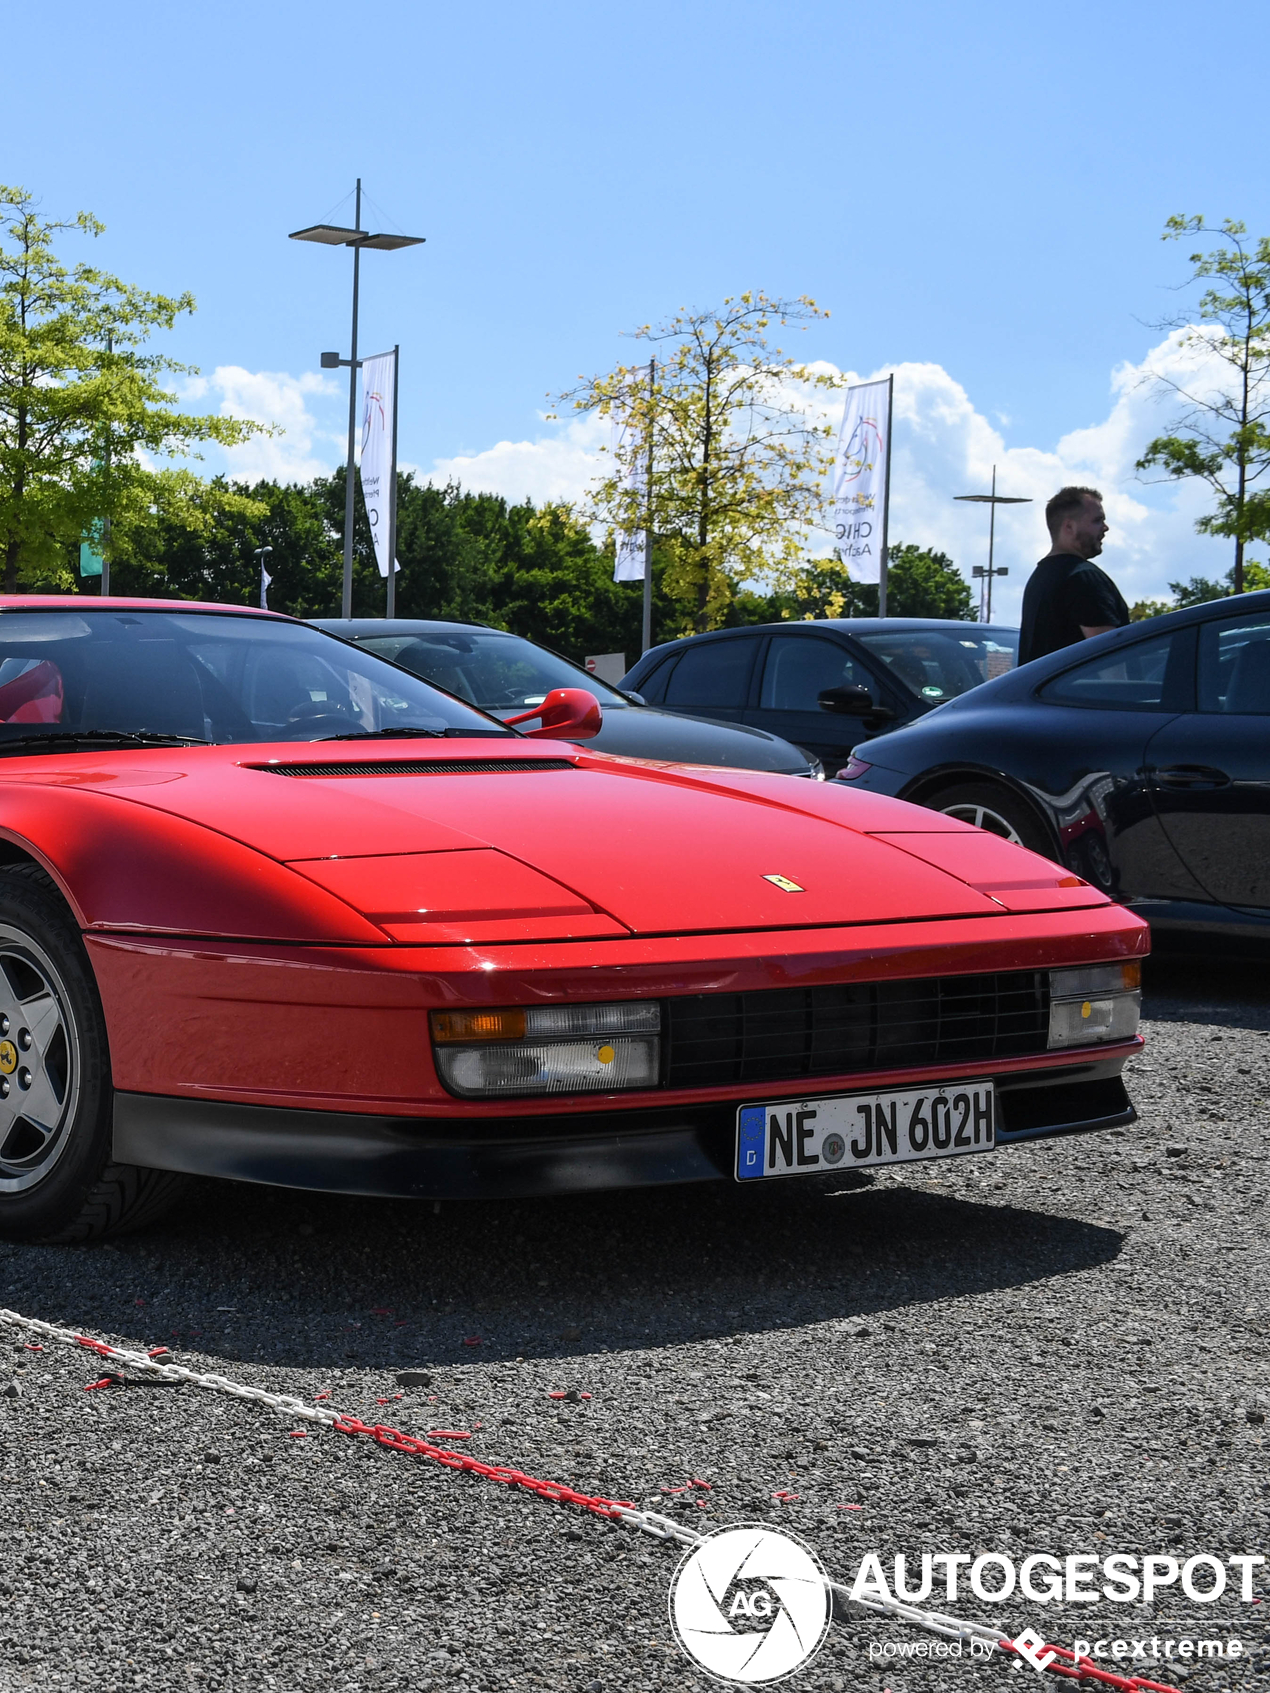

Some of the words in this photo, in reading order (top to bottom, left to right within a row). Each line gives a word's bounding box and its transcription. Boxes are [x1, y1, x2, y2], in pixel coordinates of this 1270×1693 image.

[769, 1109, 819, 1168] NE
[851, 1101, 897, 1158] JN
[909, 1090, 993, 1151] 602H
[746, 1150, 757, 1166] D
